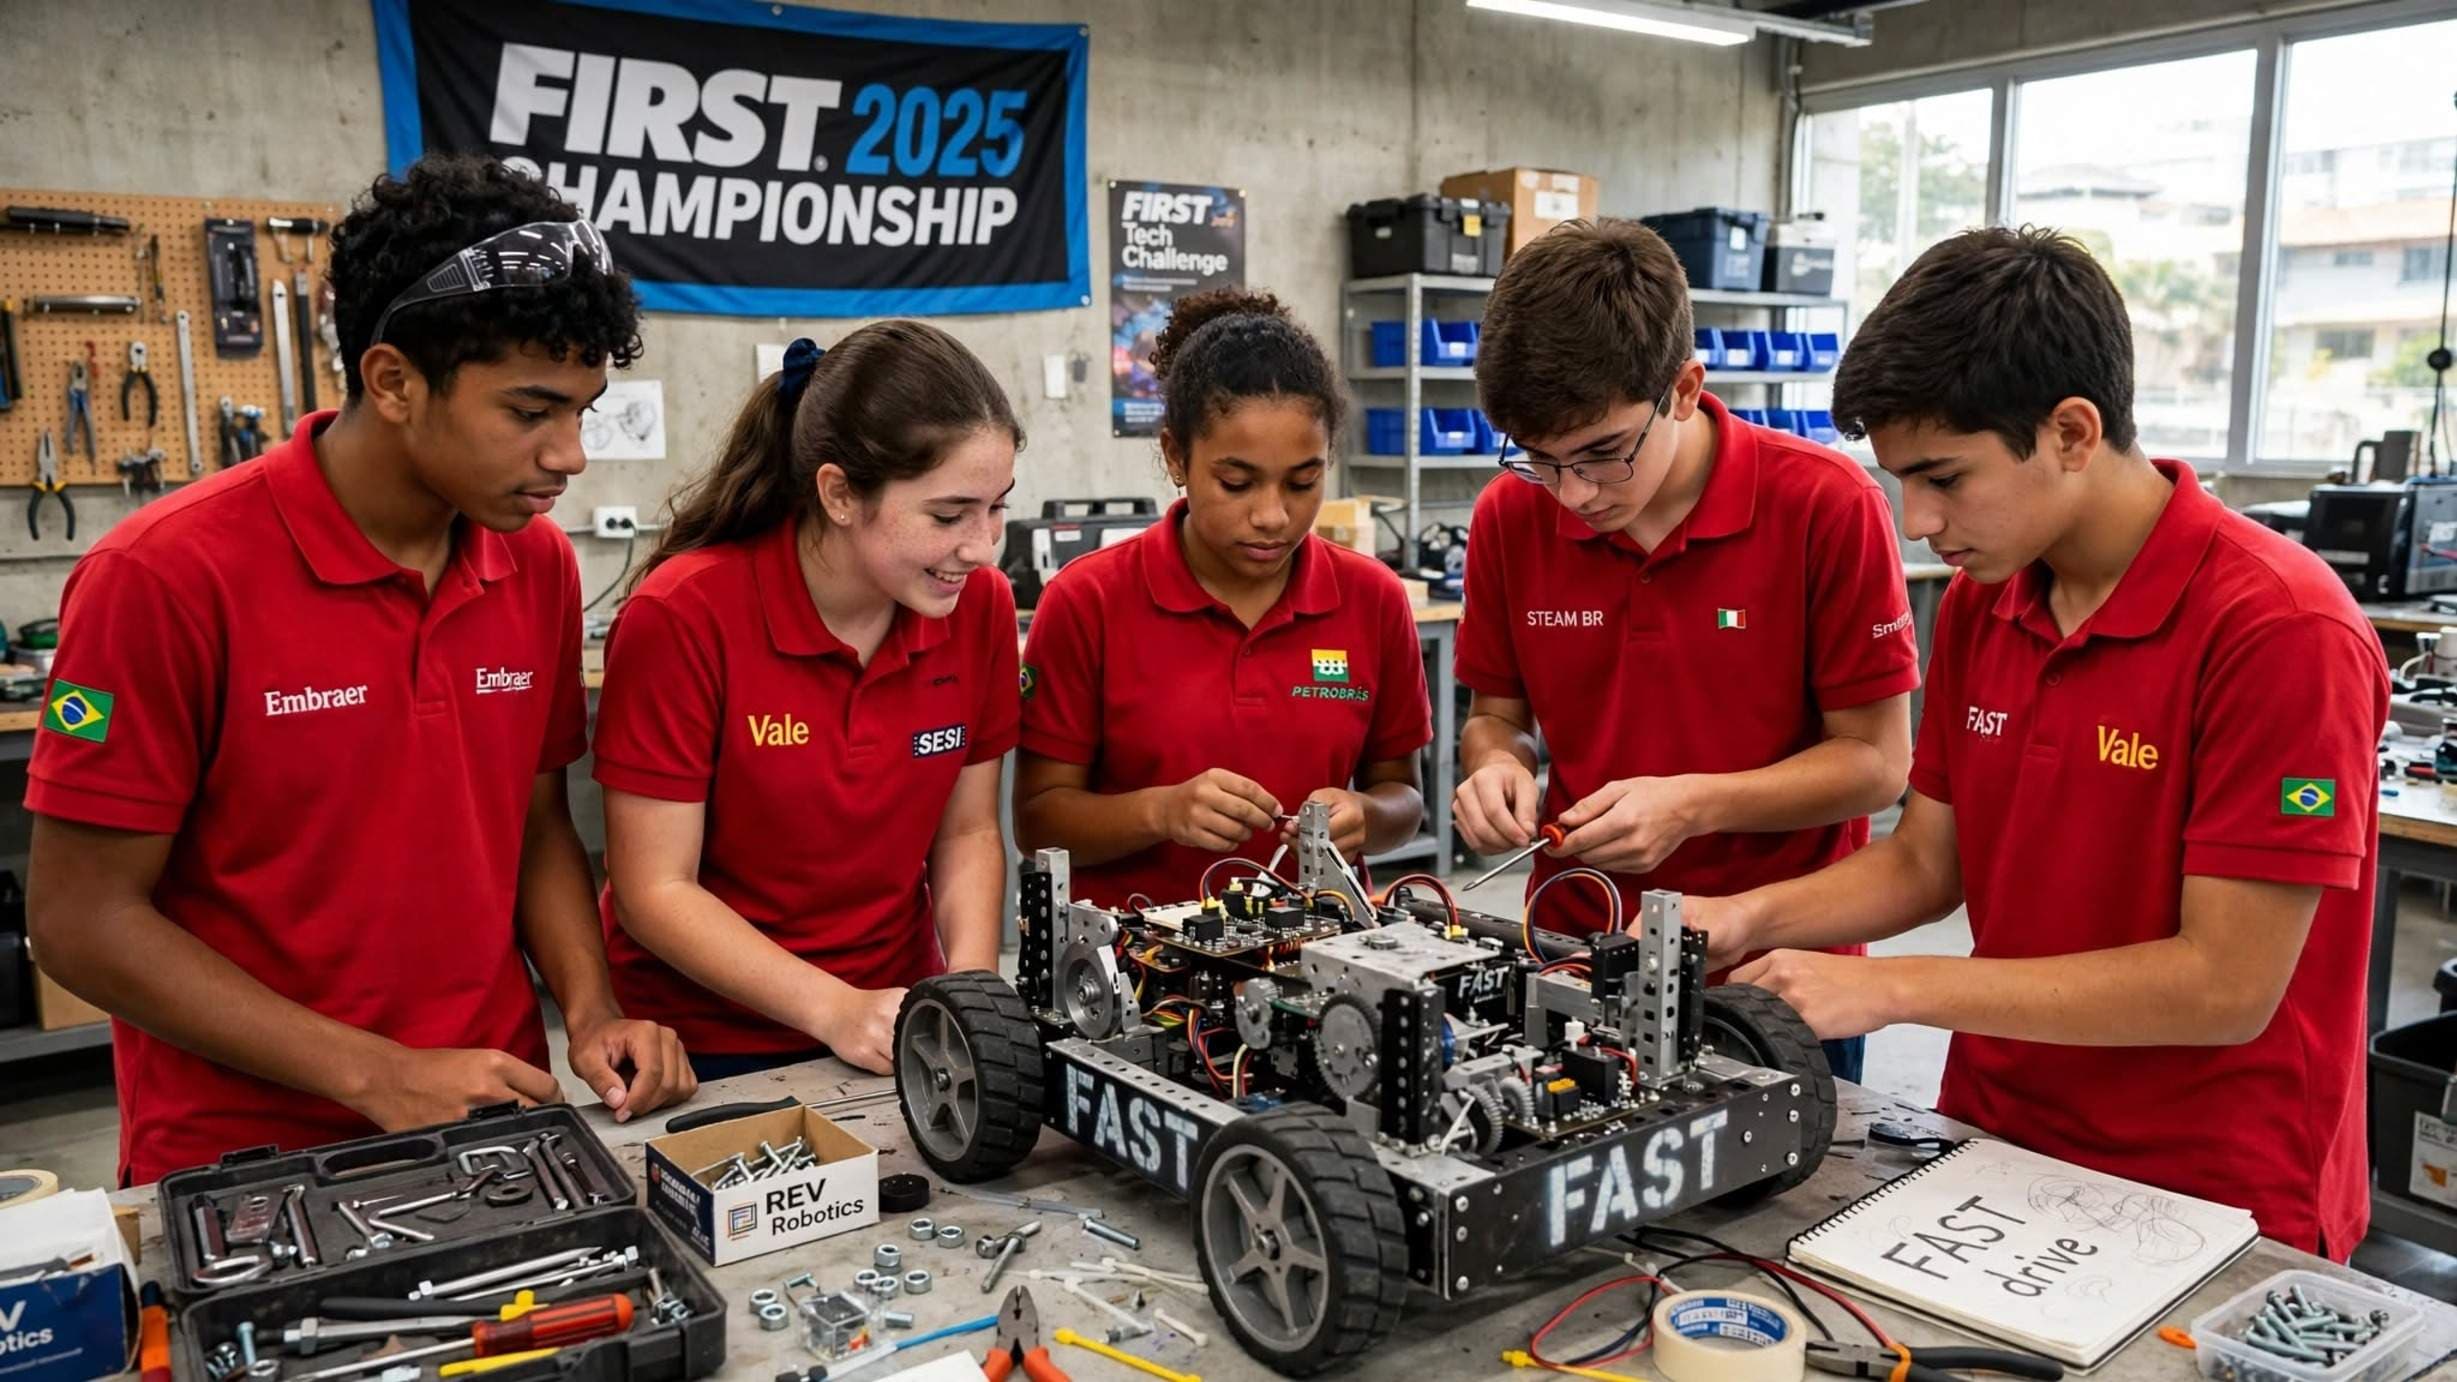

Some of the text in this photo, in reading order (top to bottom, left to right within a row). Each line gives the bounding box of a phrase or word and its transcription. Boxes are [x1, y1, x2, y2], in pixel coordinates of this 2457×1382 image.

[490, 42, 1028, 178] FIRST 2025
[1121, 191, 1213, 225] FIRST
[1121, 221, 1173, 247] Tech
[1121, 245, 1228, 276] Challenge
[1527, 610, 1604, 626] STEAM BR
[476, 667, 533, 692] Embraer
[264, 685, 368, 716] Embraer
[748, 713, 809, 746] Vale
[1966, 706, 2008, 736] FAST
[918, 727, 962, 755] SESI
[2097, 725, 2159, 770] Vale
[1458, 966, 1510, 998] FAST
[1066, 1063, 1199, 1190] FAST
[1550, 1109, 1728, 1247] FAST
[766, 1178, 826, 1215] REV
[772, 1199, 864, 1236] Robotics
[1881, 1195, 2027, 1280] FAST
[1984, 1238, 2099, 1298] drive
